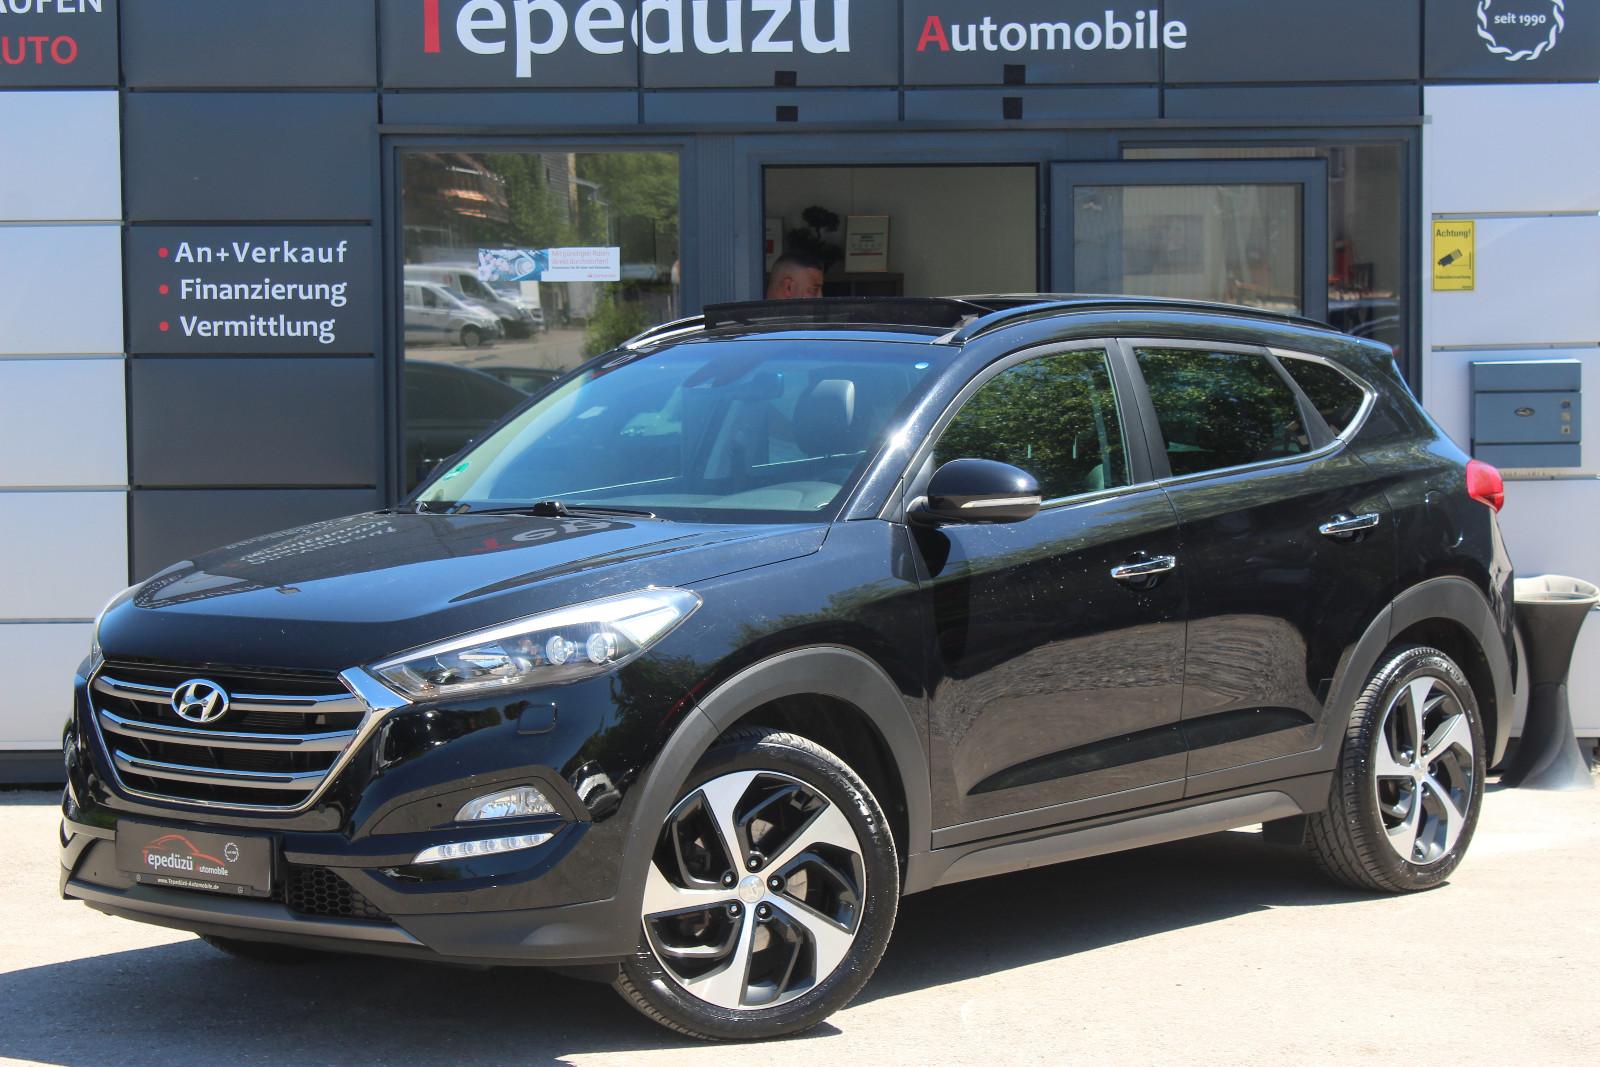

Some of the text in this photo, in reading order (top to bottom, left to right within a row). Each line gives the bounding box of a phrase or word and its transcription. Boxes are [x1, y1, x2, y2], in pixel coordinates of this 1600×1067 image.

[916, 9, 1187, 51] Automobile
[1494, 12, 1546, 26] seit 1990
[0, 35, 78, 65] UTO
[1436, 228, 1471, 239] Achtung!
[175, 240, 347, 263] An+Verkauf
[181, 278, 347, 307] Finanzierung
[180, 314, 335, 344] Vermittlung
[142, 848, 193, 871] Tepedüzü
